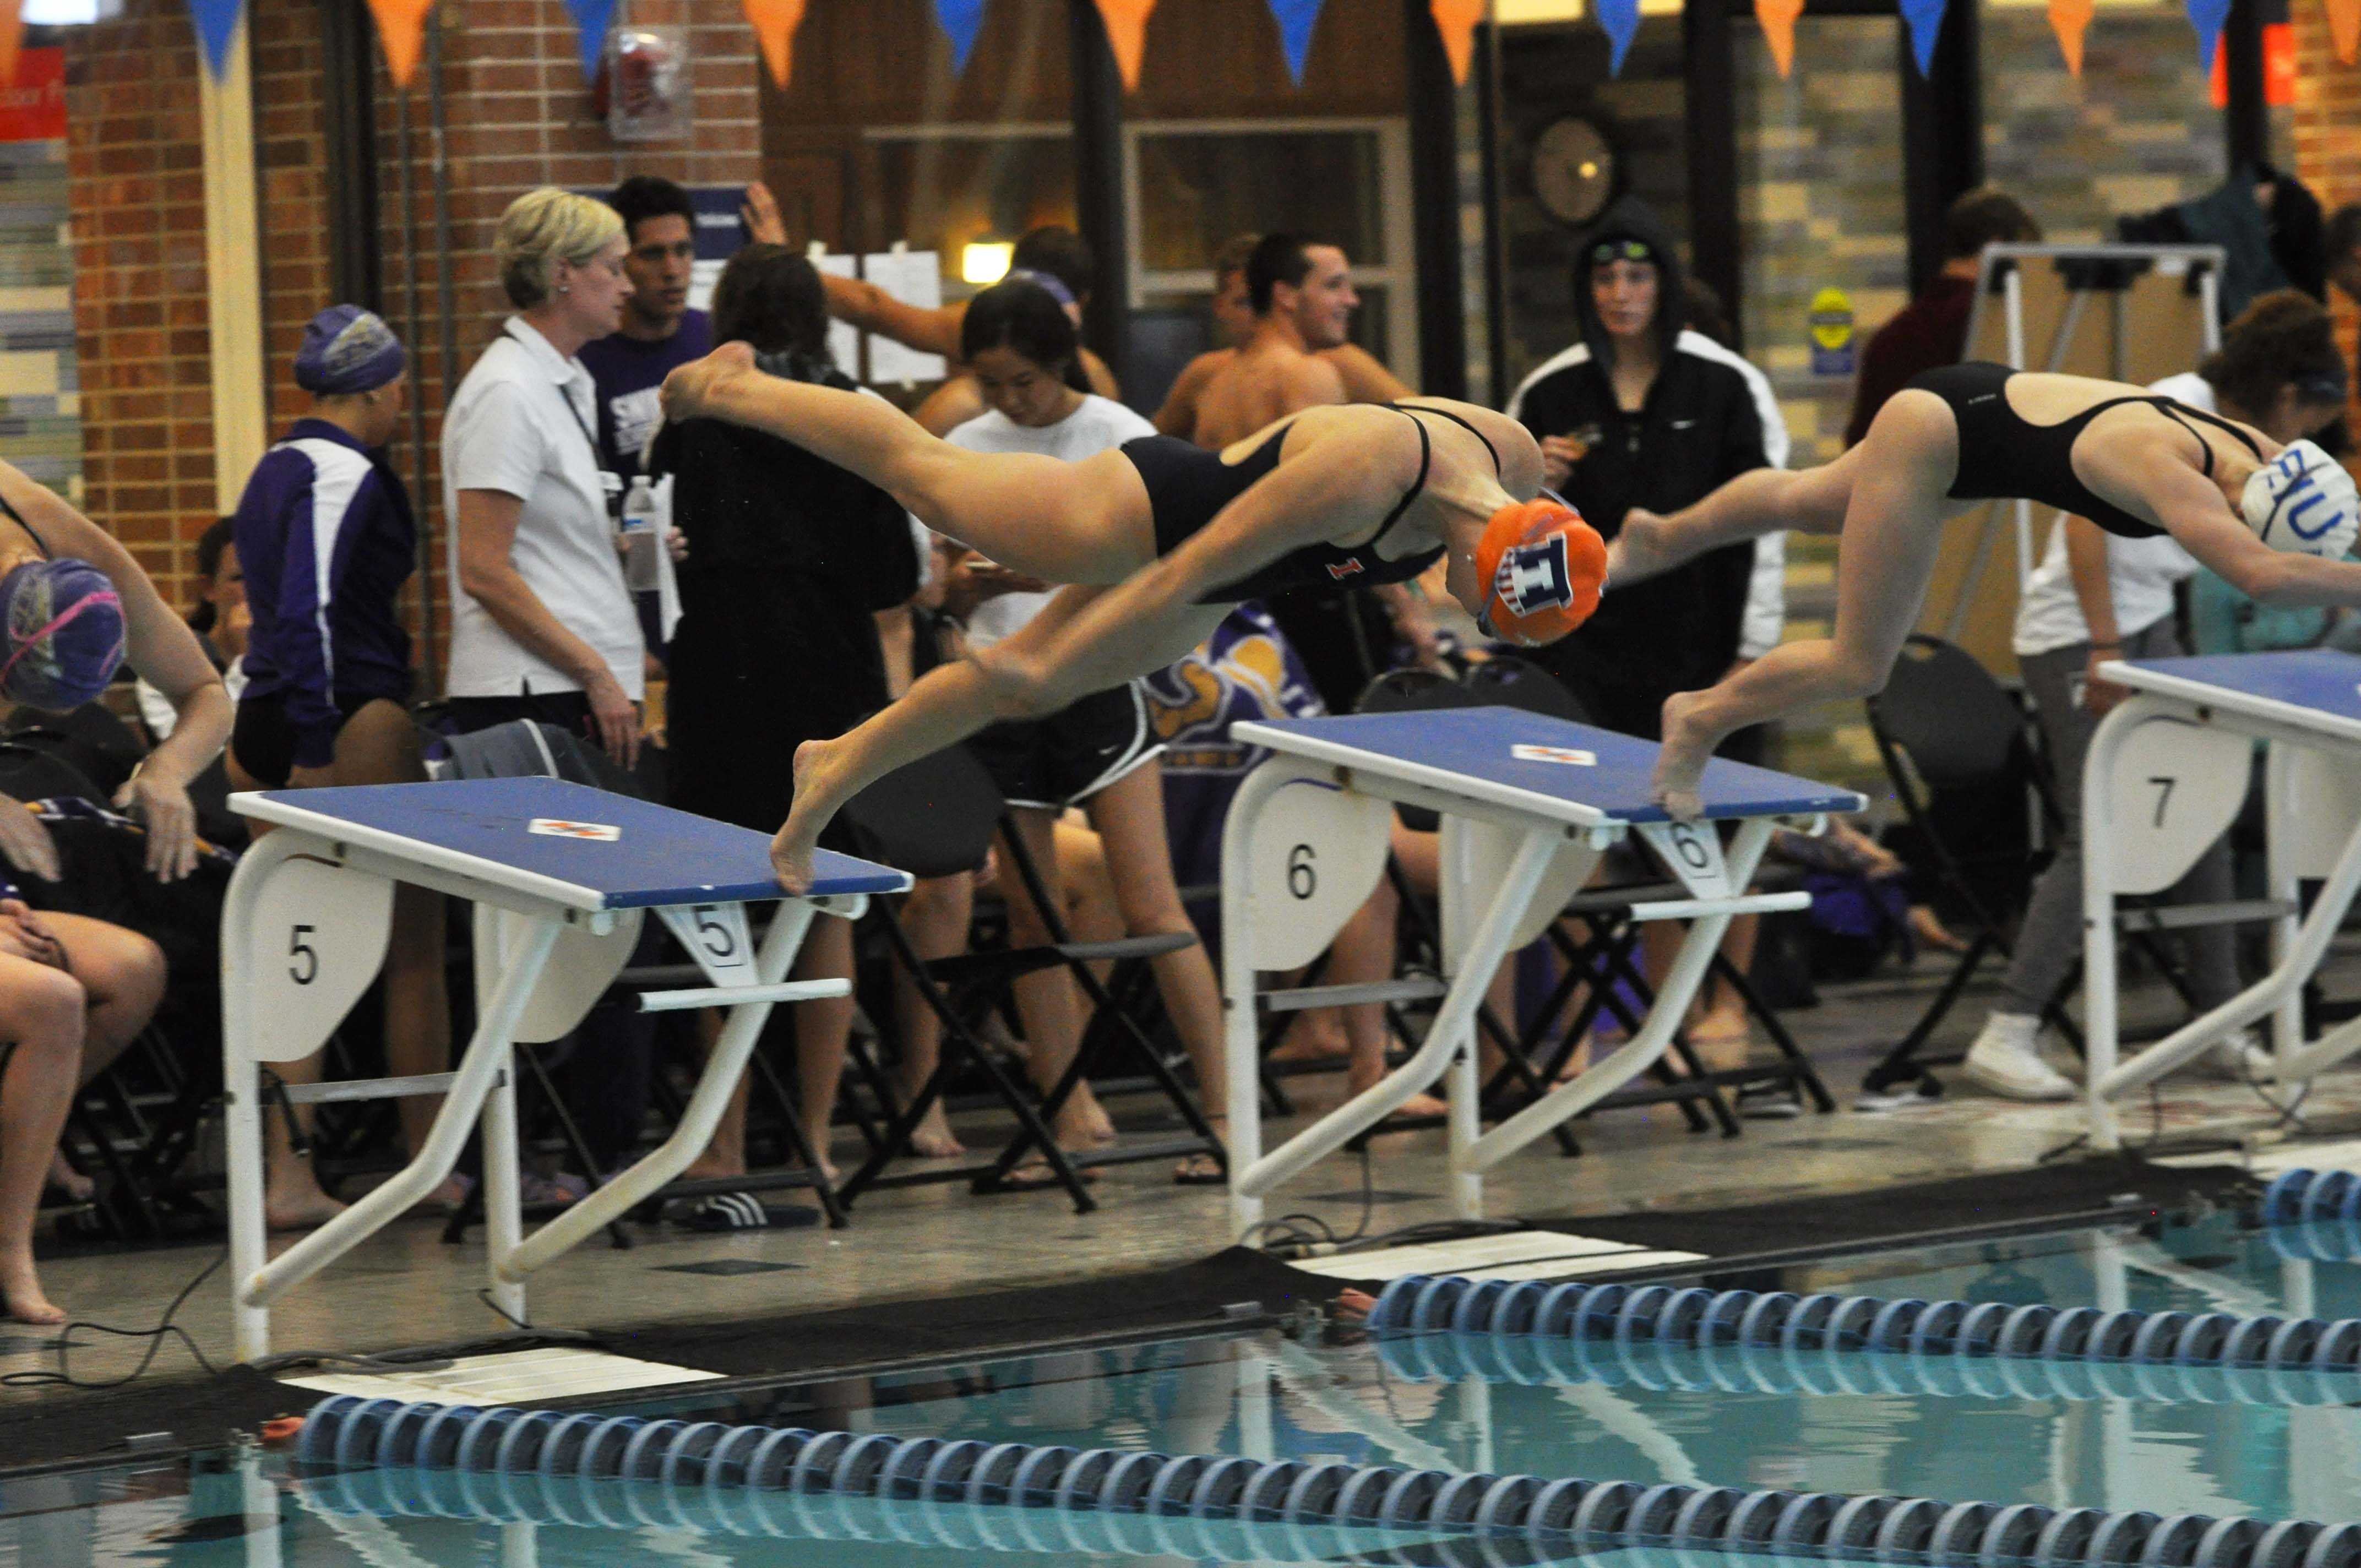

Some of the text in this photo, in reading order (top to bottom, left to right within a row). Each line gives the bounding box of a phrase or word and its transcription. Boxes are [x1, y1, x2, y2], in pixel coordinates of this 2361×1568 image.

[1324, 557, 1366, 581] I
[2147, 776, 2175, 829] 7
[1669, 821, 1709, 868] 6
[1287, 843, 1317, 900] 6
[290, 924, 318, 985] 5
[692, 905, 735, 957] 5
